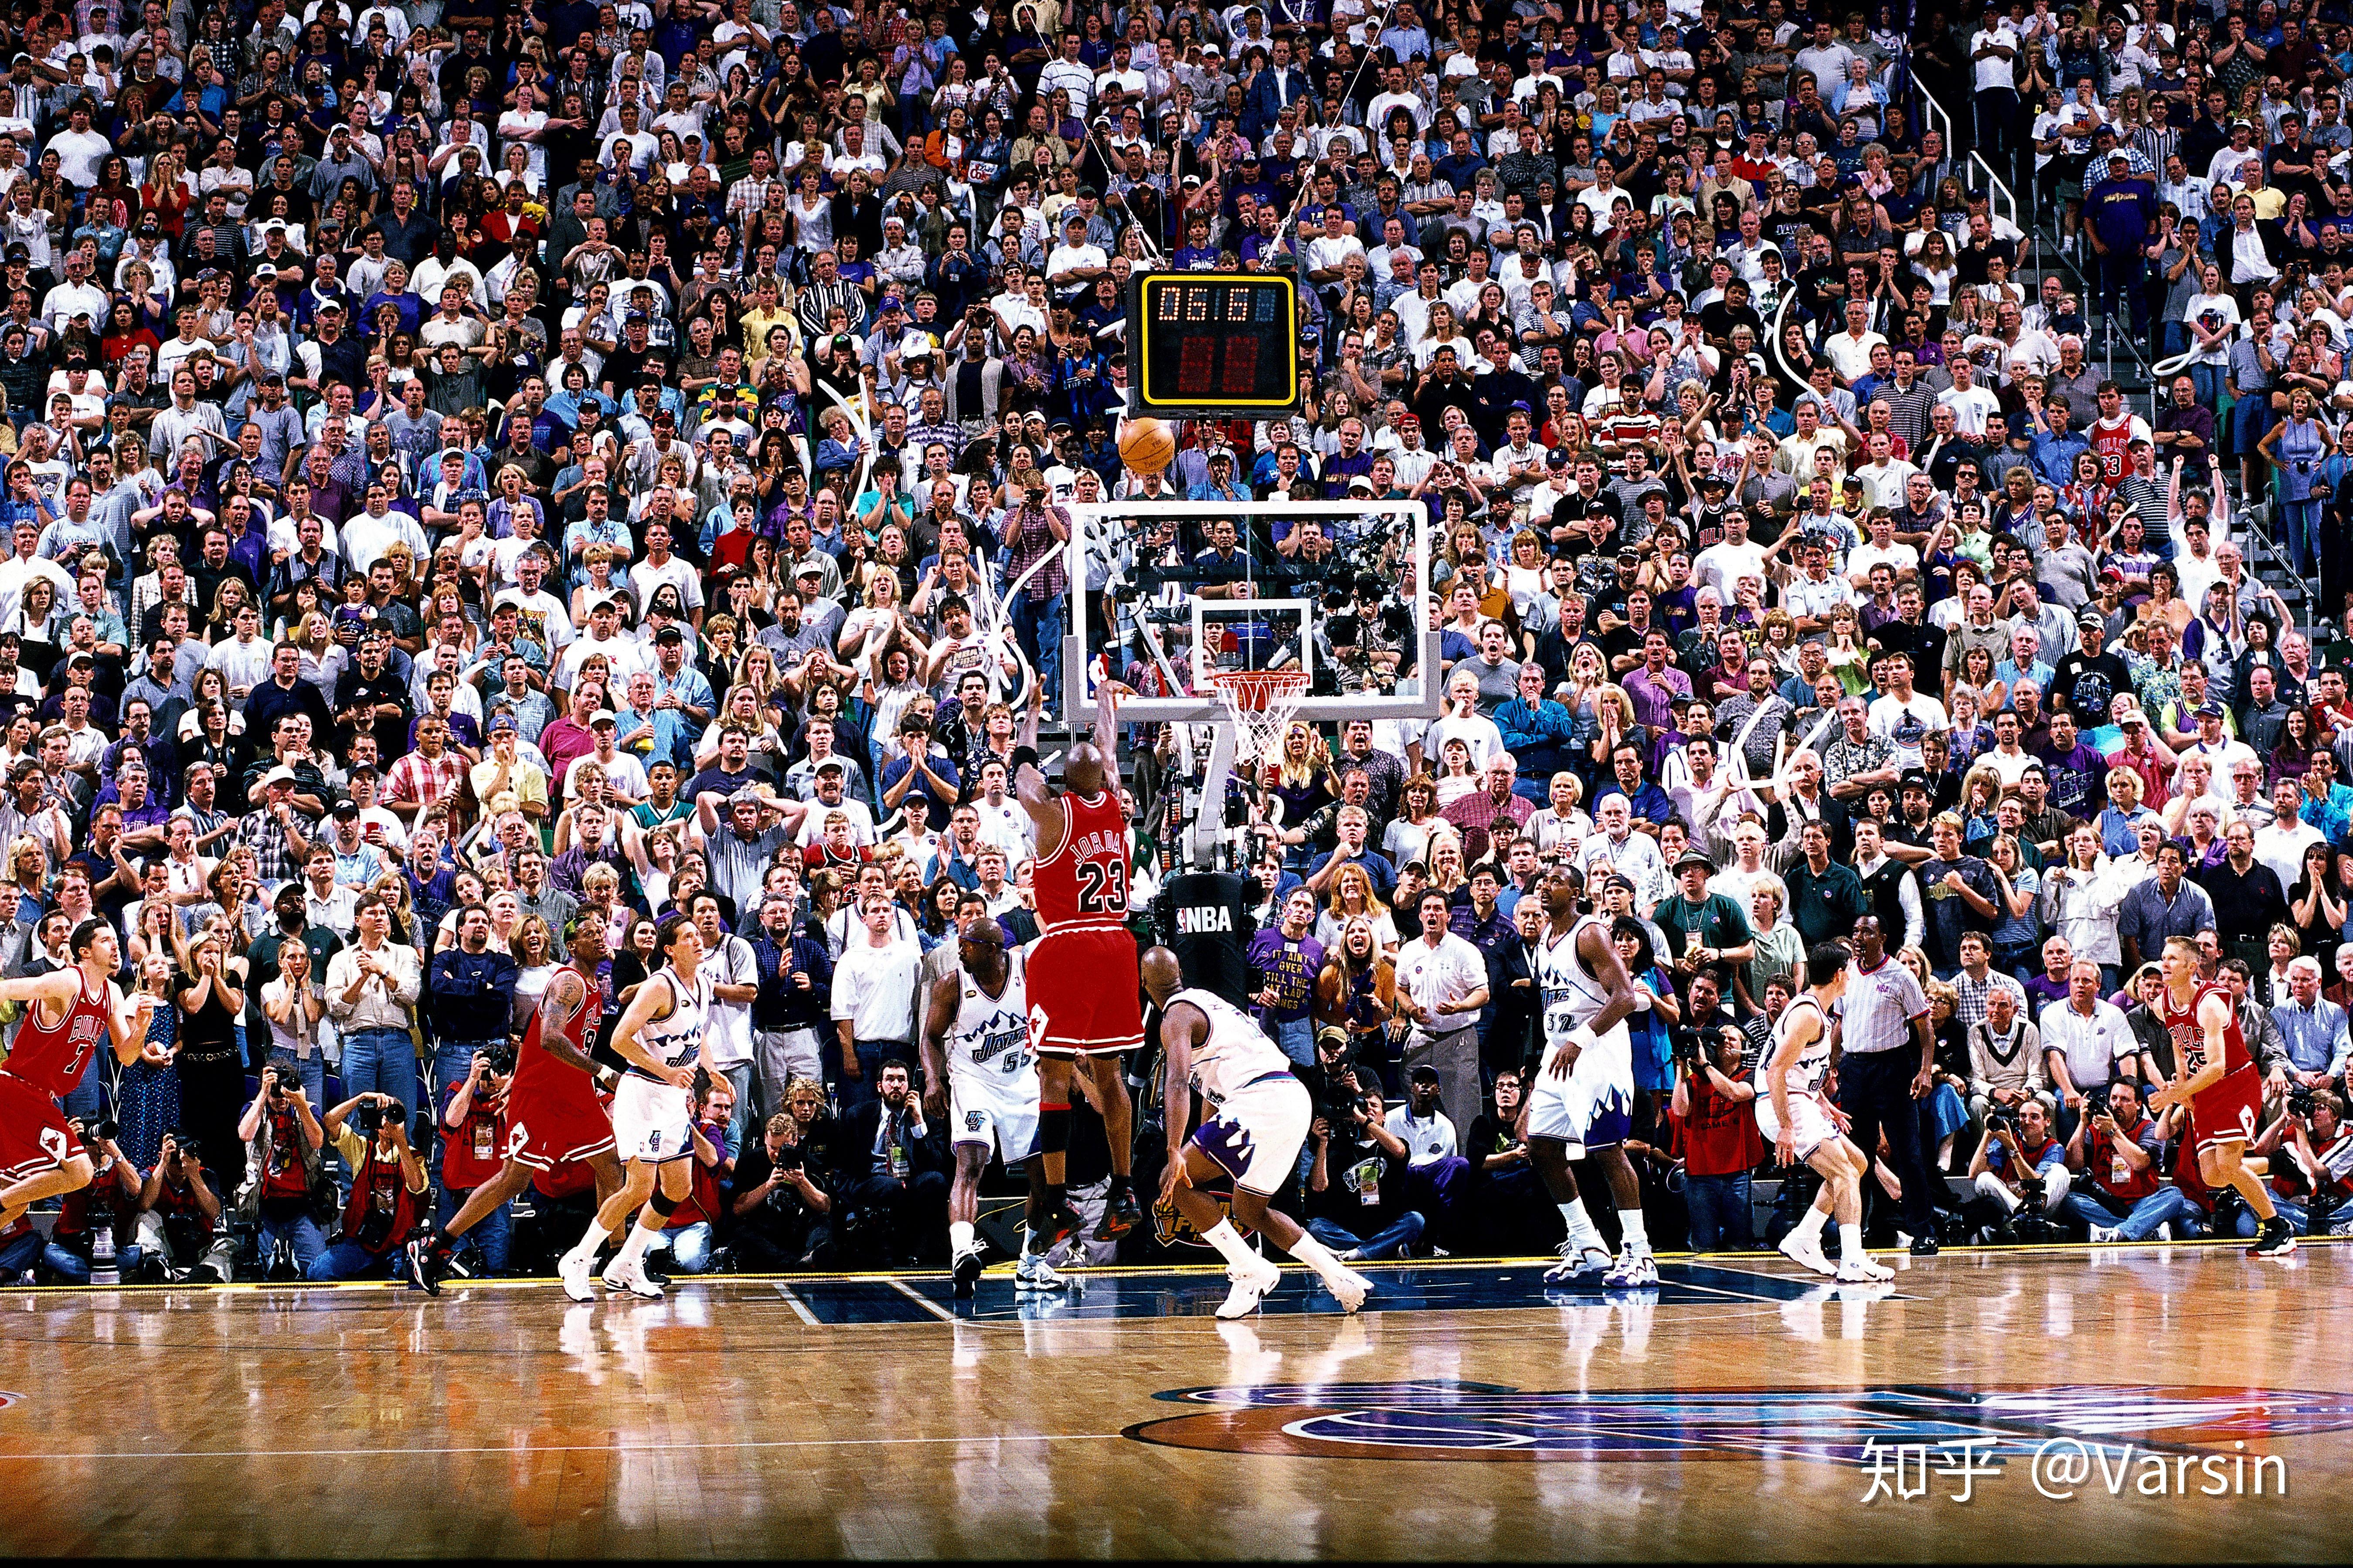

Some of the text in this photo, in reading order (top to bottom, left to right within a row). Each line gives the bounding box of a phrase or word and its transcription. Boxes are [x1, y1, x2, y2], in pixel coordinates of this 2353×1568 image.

[1775, 224, 1809, 235] JAZ
[1699, 527, 1723, 548] BULL
[1070, 830, 1122, 865] JORDA
[1076, 858, 1129, 913] 23
[1186, 906, 1232, 933] NBA
[1272, 950, 1282, 959] IT
[1279, 961, 1302, 974] OVER
[1265, 972, 1309, 988] TILL THE
[1876, 984, 1889, 993] NBA
[1265, 983, 1306, 999] AT LADY
[1278, 998, 1298, 1010] INGS
[1547, 1011, 1577, 1033] 32
[972, 1029, 1027, 1062] JAZZ
[64, 1044, 89, 1074] 7
[1003, 1052, 1031, 1073] 55
